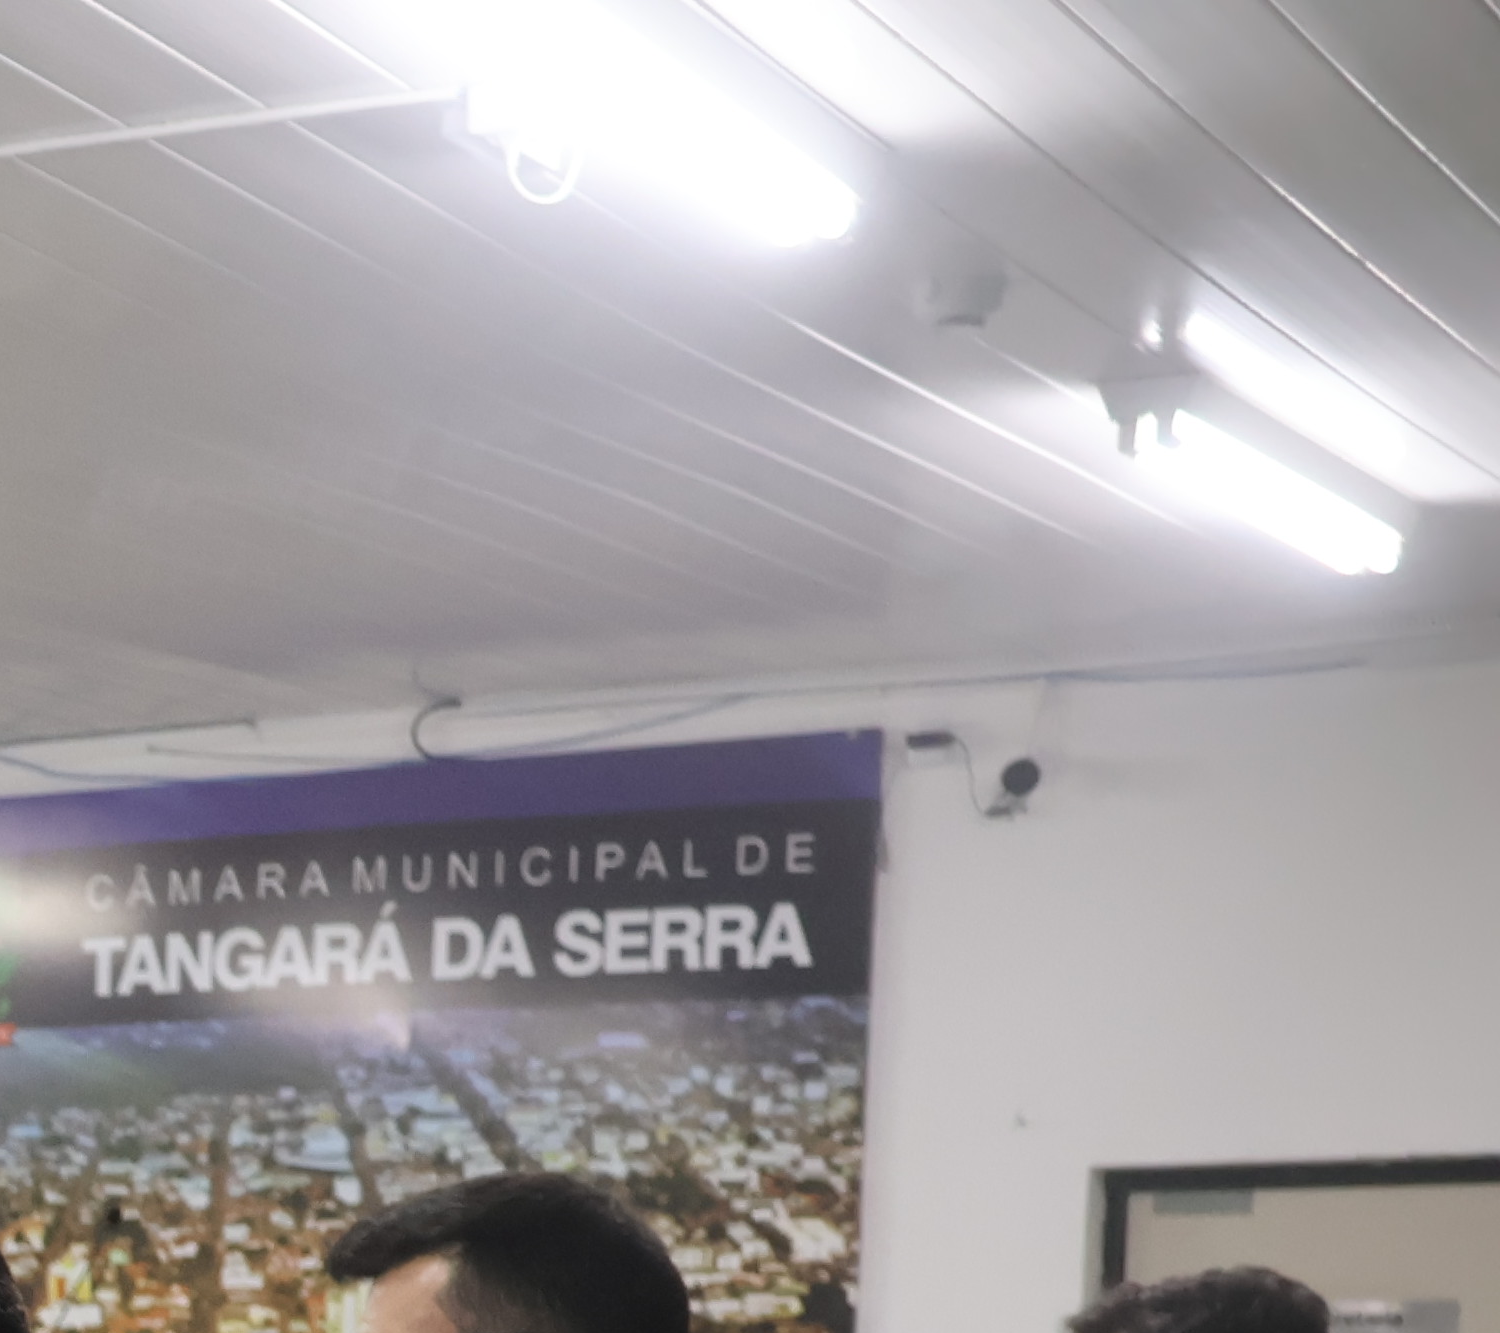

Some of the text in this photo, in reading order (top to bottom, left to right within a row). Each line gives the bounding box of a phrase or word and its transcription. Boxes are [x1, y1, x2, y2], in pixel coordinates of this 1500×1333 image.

[84, 832, 815, 913] CÂMARA MUNICIPAL DE
[80, 900, 813, 998] TANGARÁ DA SERRA
